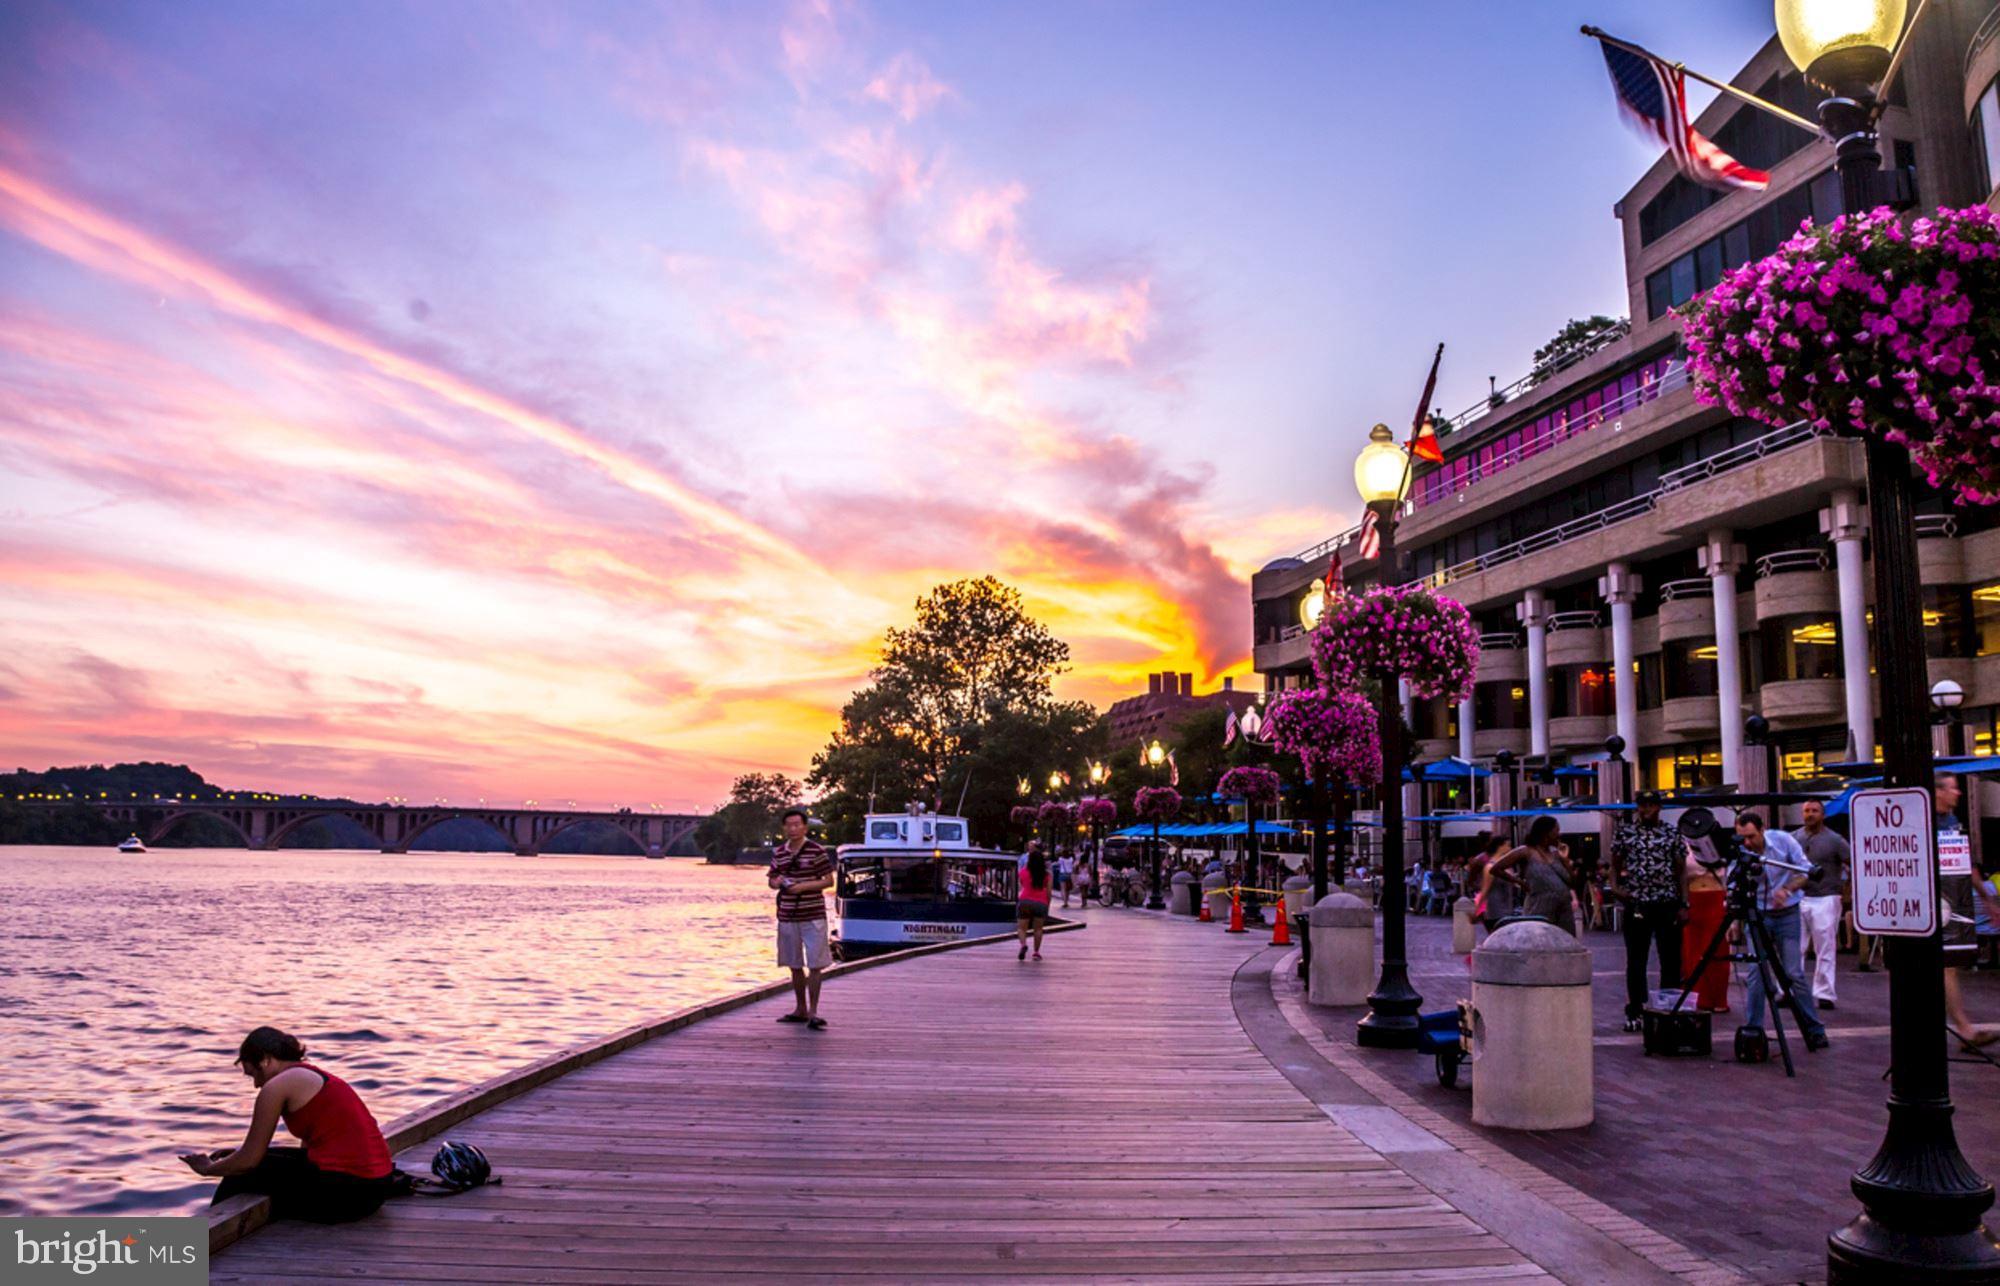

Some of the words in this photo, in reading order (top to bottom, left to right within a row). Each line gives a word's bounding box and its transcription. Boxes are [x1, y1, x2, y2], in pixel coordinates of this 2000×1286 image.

[1875, 804, 1904, 828] NO
[1863, 835, 1919, 854] MOORING
[1864, 858, 1920, 877] MIDNIGHT
[1888, 881, 1898, 895] TO
[1867, 898, 1898, 917] 6:00
[1903, 898, 1921, 917] AM
[903, 924, 966, 934] NIGHTINGALE
